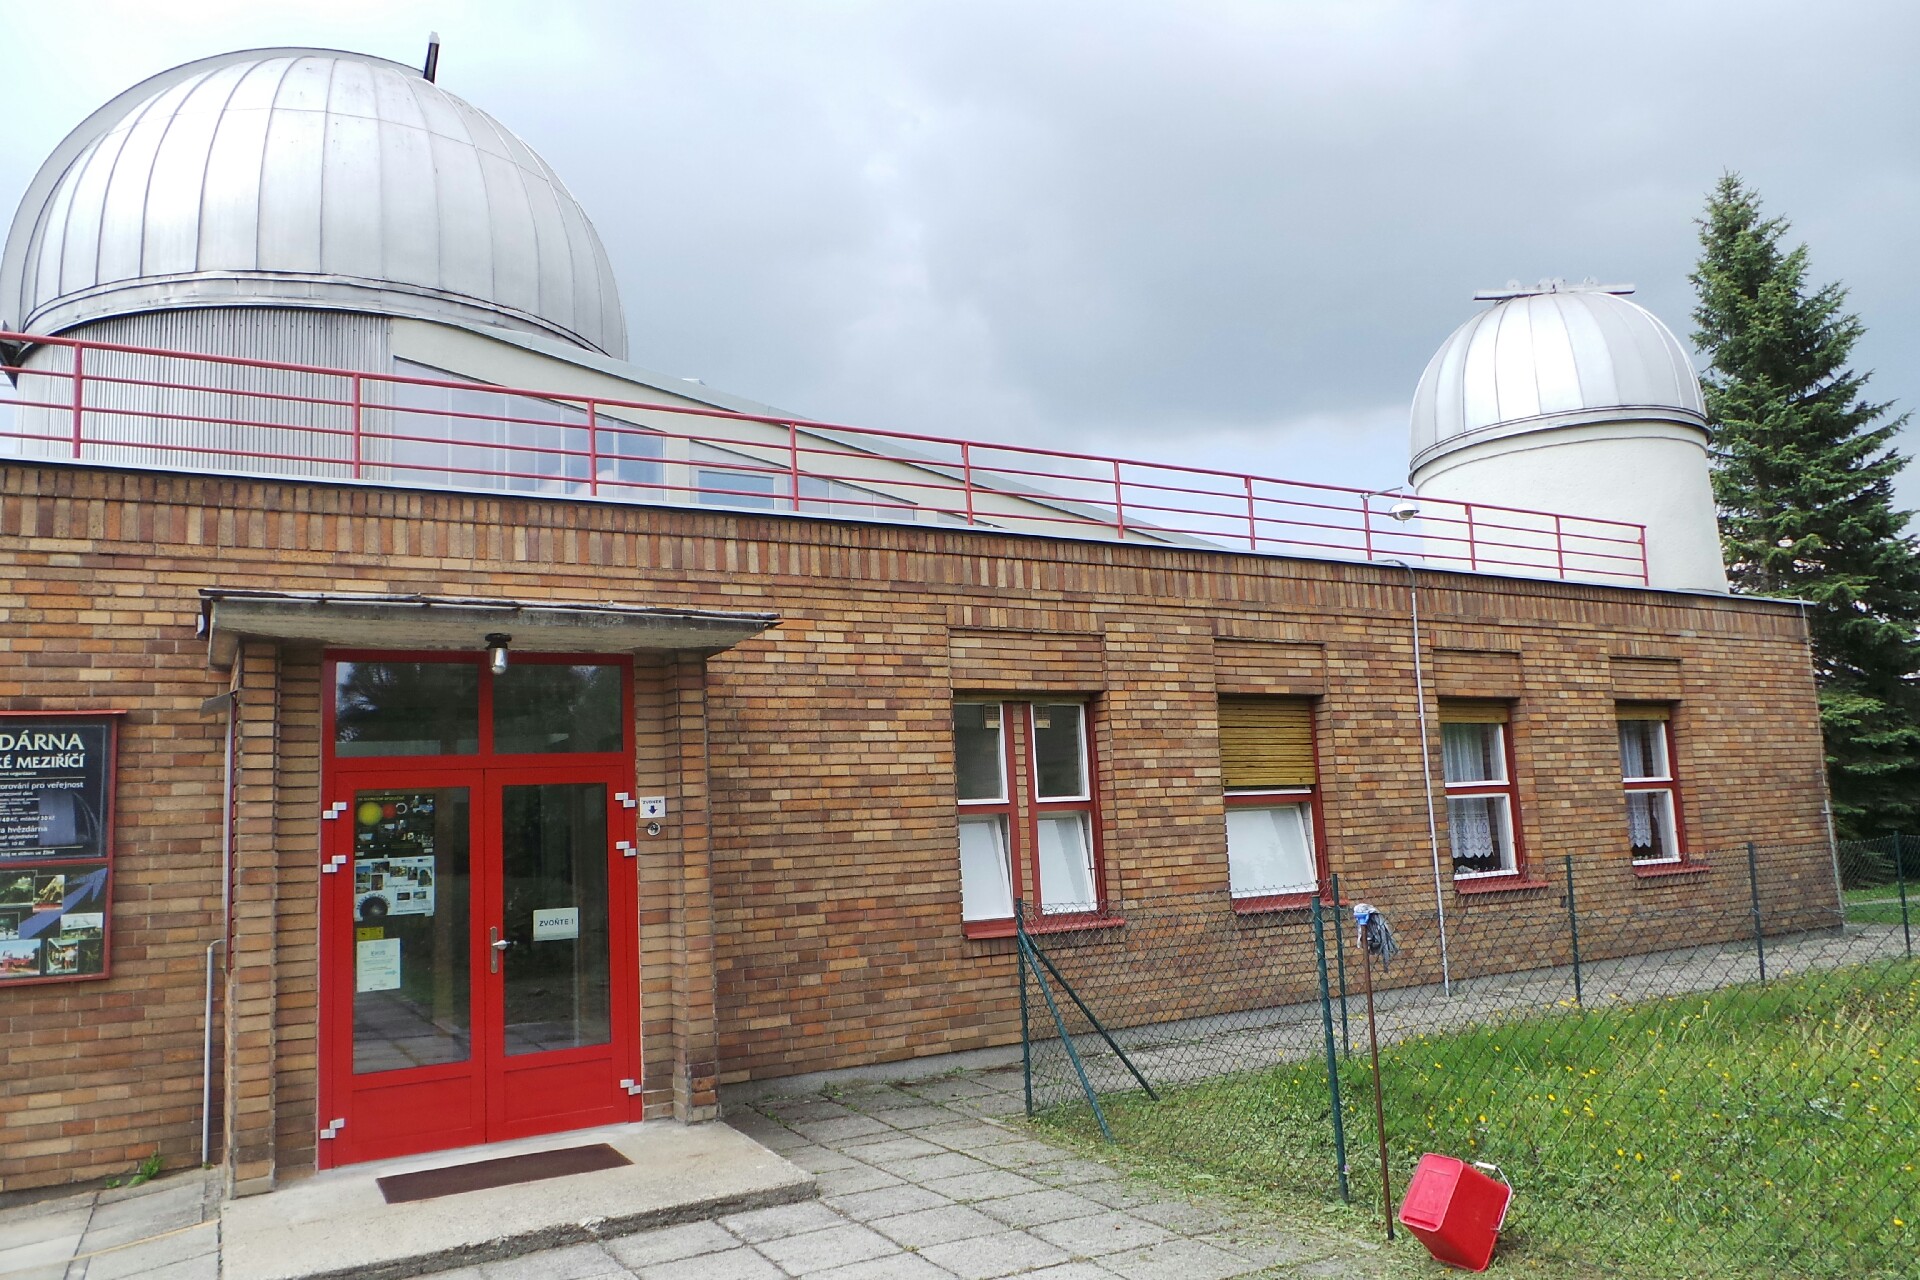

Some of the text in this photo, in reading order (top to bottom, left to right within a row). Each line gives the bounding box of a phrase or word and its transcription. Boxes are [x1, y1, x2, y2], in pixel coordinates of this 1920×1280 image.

[0, 729, 85, 751] DÁRNA
[16, 753, 85, 769] MEZIŘÍČÍ
[31, 782, 45, 791] pro
[47, 781, 84, 790] veřejnost
[539, 918, 569, 927] ZVOŇTE
